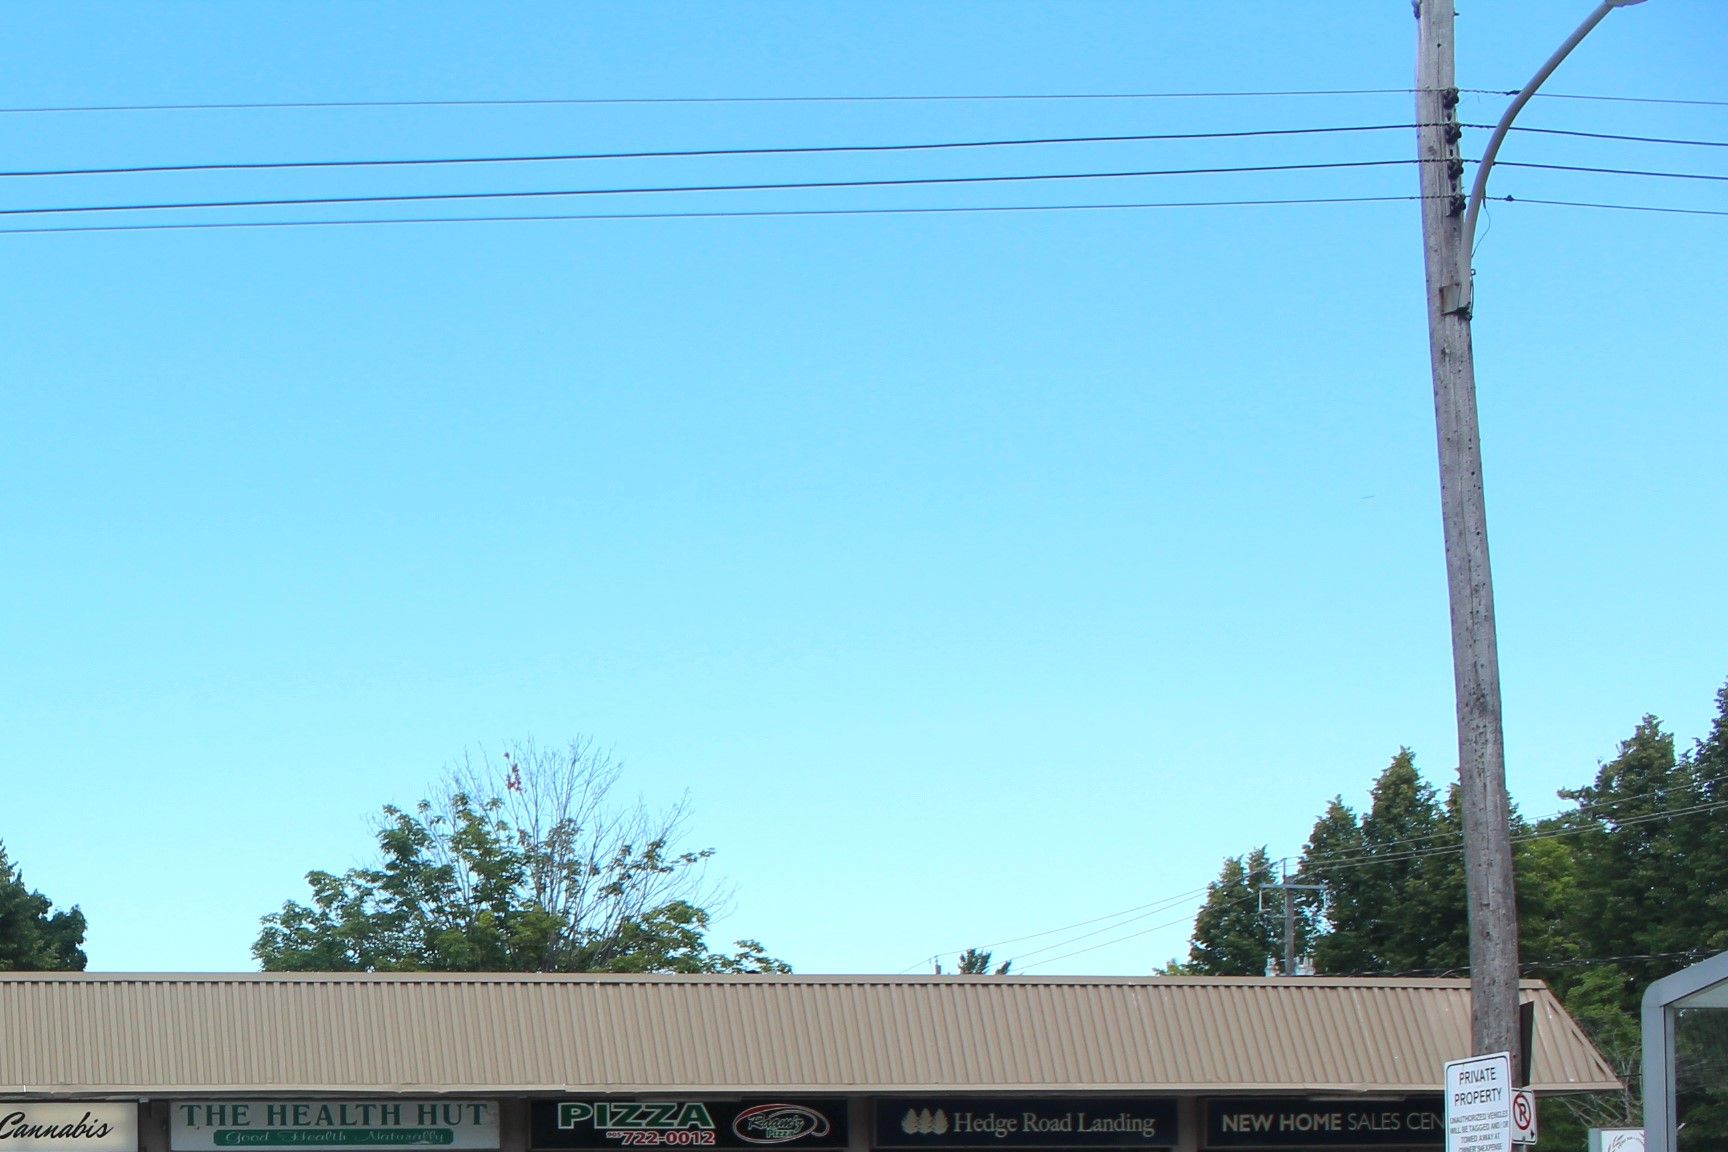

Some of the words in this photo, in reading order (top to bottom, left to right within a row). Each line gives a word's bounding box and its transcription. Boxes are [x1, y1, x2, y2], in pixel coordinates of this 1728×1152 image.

[1459, 1067, 1497, 1085] PRIVATE
[1454, 1088, 1503, 1107] PROPERTY
[180, 1103, 251, 1126] THE
[267, 1103, 401, 1126] HEALTH
[417, 1103, 488, 1126] HUT
[558, 1102, 715, 1129] PIZZA
[1222, 1113, 1273, 1132] NEW
[1280, 1113, 1342, 1131] HOME
[1348, 1113, 1401, 1130] SALES
[954, 1113, 1018, 1137] Hedge
[1023, 1113, 1072, 1132] Road
[1077, 1113, 1156, 1137] Landing
[225, 1131, 273, 1145] Good
[278, 1130, 347, 1143] Health
[355, 1129, 445, 1145] Naturally
[622, 1130, 715, 1145] 722-0012
